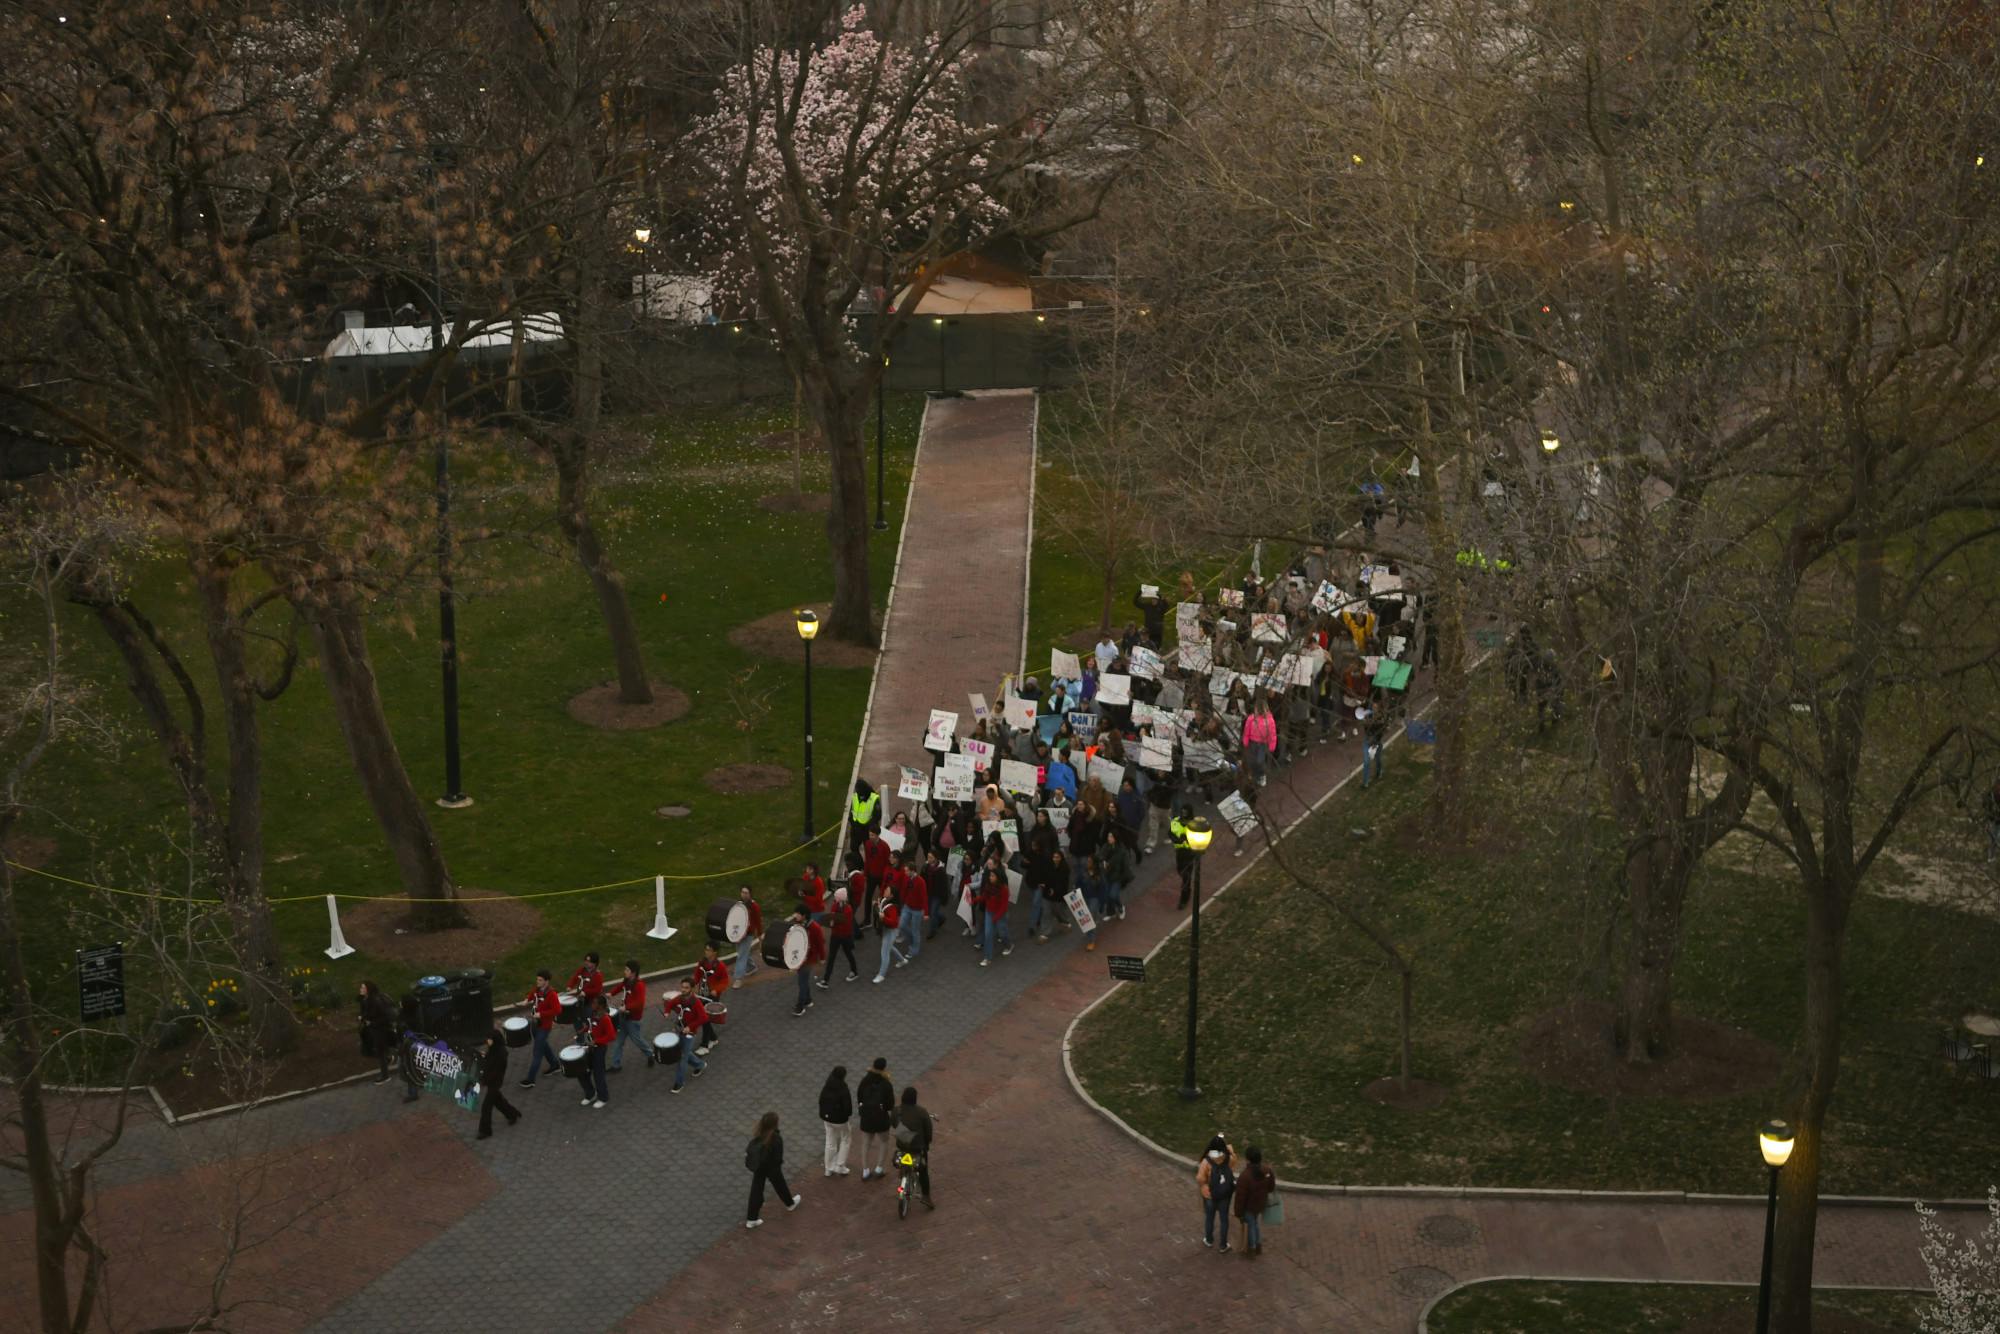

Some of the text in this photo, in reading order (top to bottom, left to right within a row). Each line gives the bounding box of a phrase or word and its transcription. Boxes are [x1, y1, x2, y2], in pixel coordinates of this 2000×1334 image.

[415, 1055, 432, 1069] THE
[432, 1061, 459, 1080] NIGHT
[416, 1044, 463, 1072] TAKE BACK
